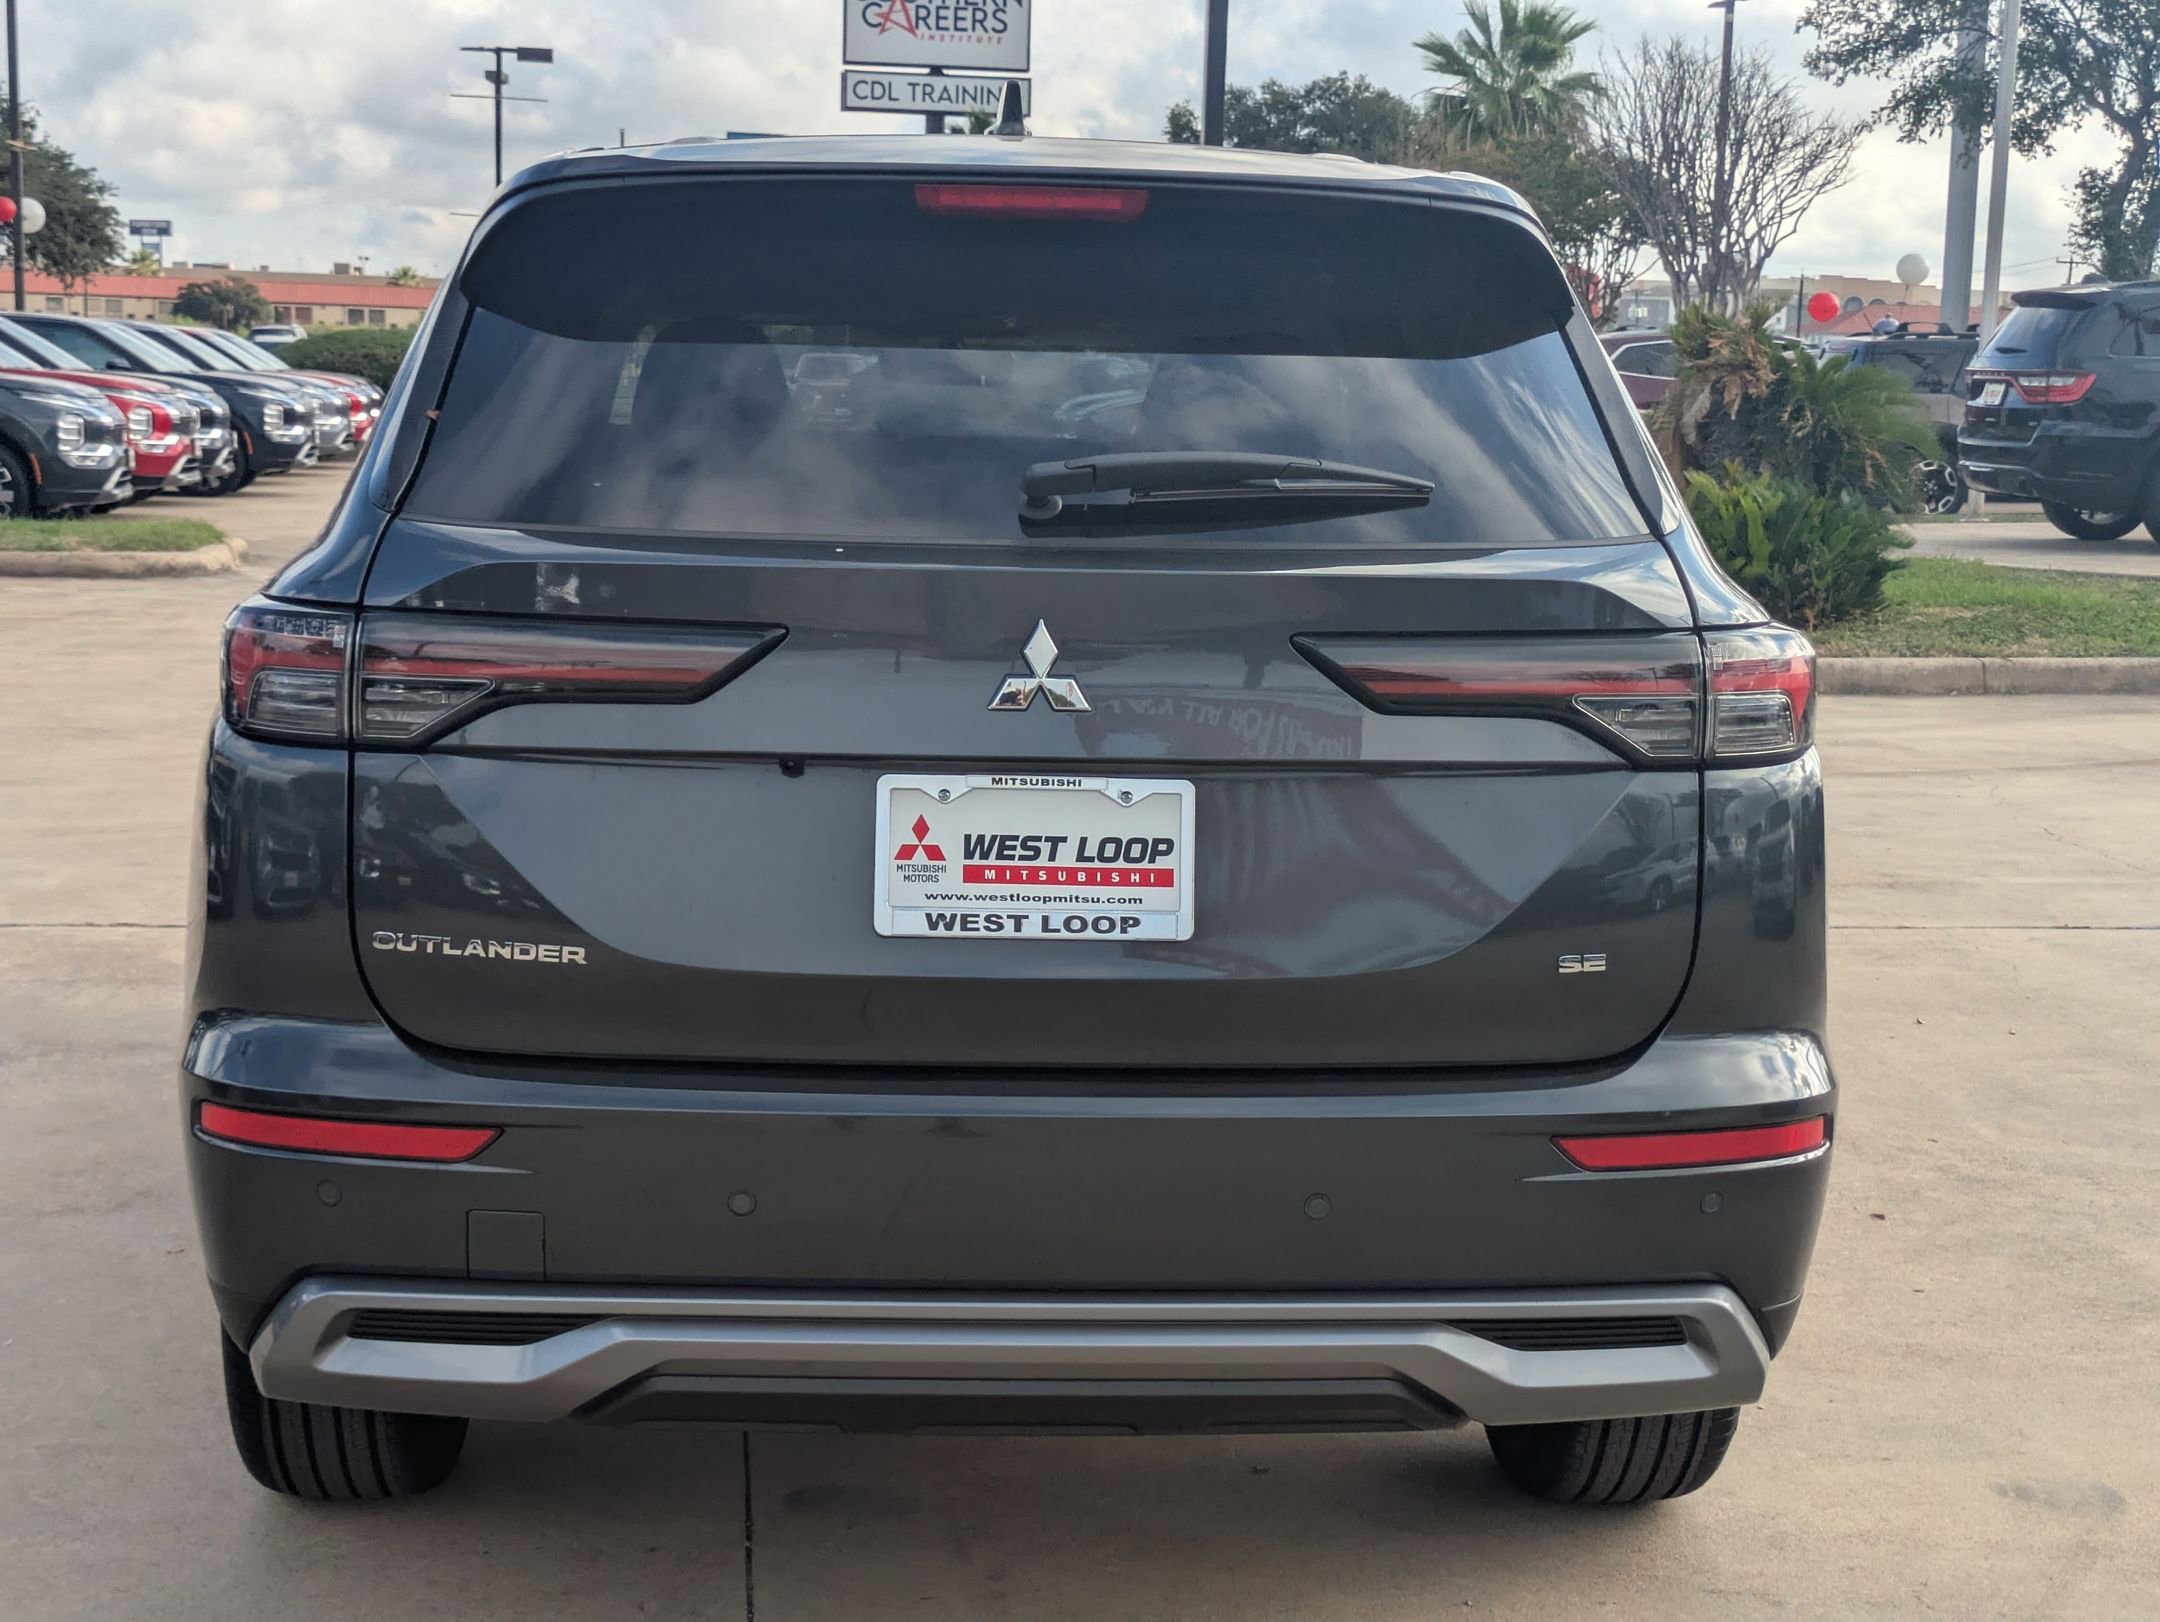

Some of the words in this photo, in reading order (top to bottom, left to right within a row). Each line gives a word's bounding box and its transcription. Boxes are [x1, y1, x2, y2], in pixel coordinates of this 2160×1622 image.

[862, 1, 1008, 38] CAREERS
[920, 33, 1003, 45] INSTITUTE
[853, 80, 899, 101] CDL
[908, 82, 1003, 106] TRAININ
[991, 776, 1082, 788] MITSUBISHI
[963, 833, 1067, 862] WEST
[1075, 836, 1175, 865] LOOP
[896, 863, 947, 873] MITSUBISHI
[903, 873, 940, 883] MOTORS
[984, 869, 1155, 884] MITSUBISHI
[924, 892, 1143, 905] www.westloopmitsu.com
[925, 912, 1029, 933] WEST
[1041, 914, 1141, 934] LOOP
[371, 930, 588, 965] OUTLANDER
[1558, 953, 1607, 974] SE
